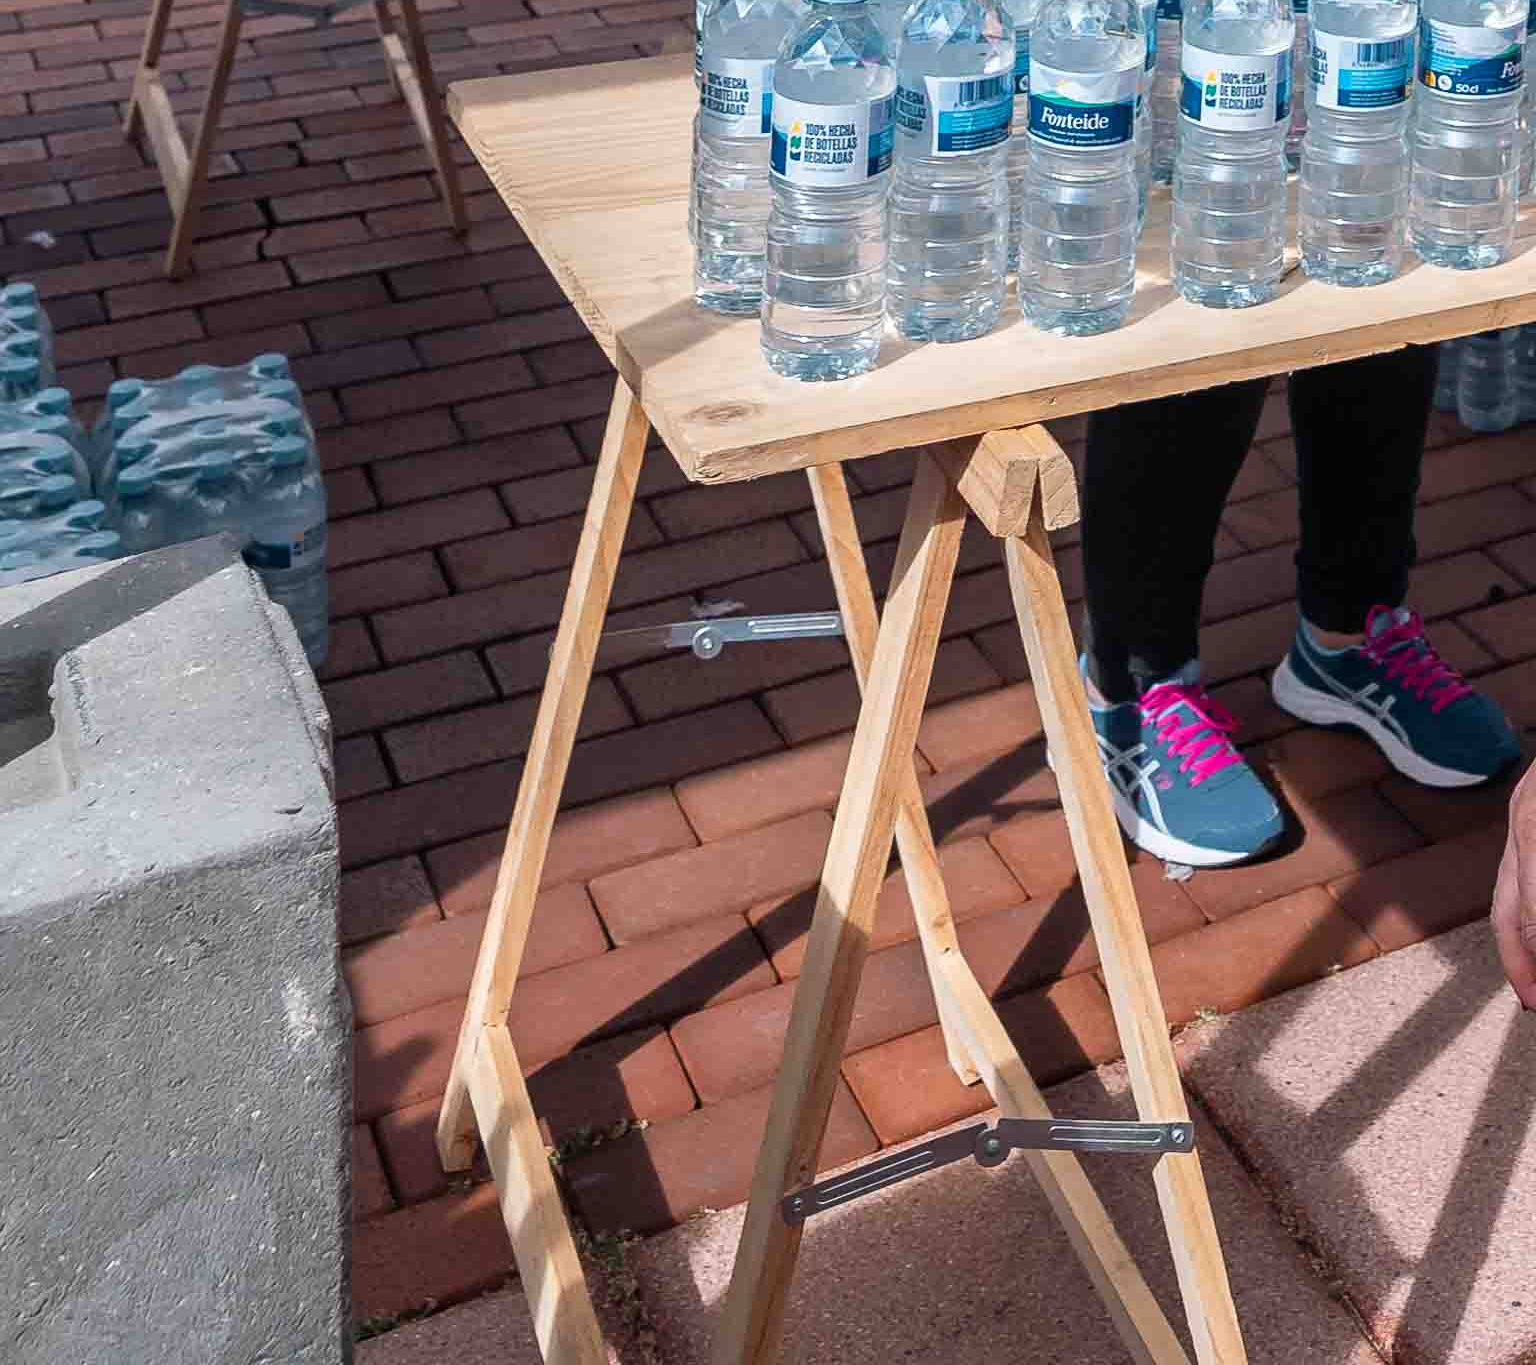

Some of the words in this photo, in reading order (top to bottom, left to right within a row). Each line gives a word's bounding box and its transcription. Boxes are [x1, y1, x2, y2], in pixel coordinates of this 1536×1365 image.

[1041, 106, 1109, 130] Fonteide
[805, 123, 827, 137] 100%
[829, 123, 856, 137] HECHA
[804, 137, 815, 150] DE
[816, 137, 857, 151] BOTELLAS
[804, 151, 854, 165] RECICLADAS
